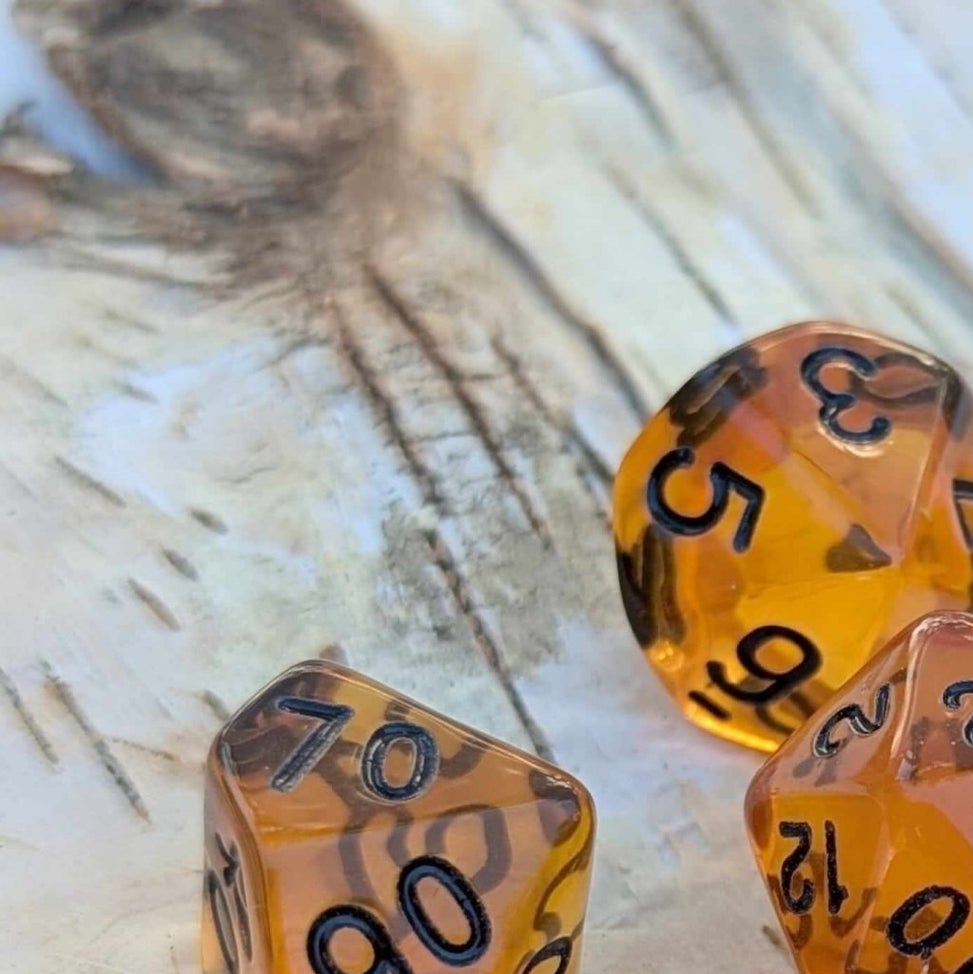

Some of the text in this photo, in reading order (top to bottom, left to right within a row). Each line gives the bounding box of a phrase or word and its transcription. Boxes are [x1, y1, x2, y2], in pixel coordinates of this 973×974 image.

[800, 346, 892, 444] 3
[646, 446, 766, 553] 5
[270, 696, 441, 802] 70
[811, 683, 892, 758] 2
[779, 819, 849, 915] 12
